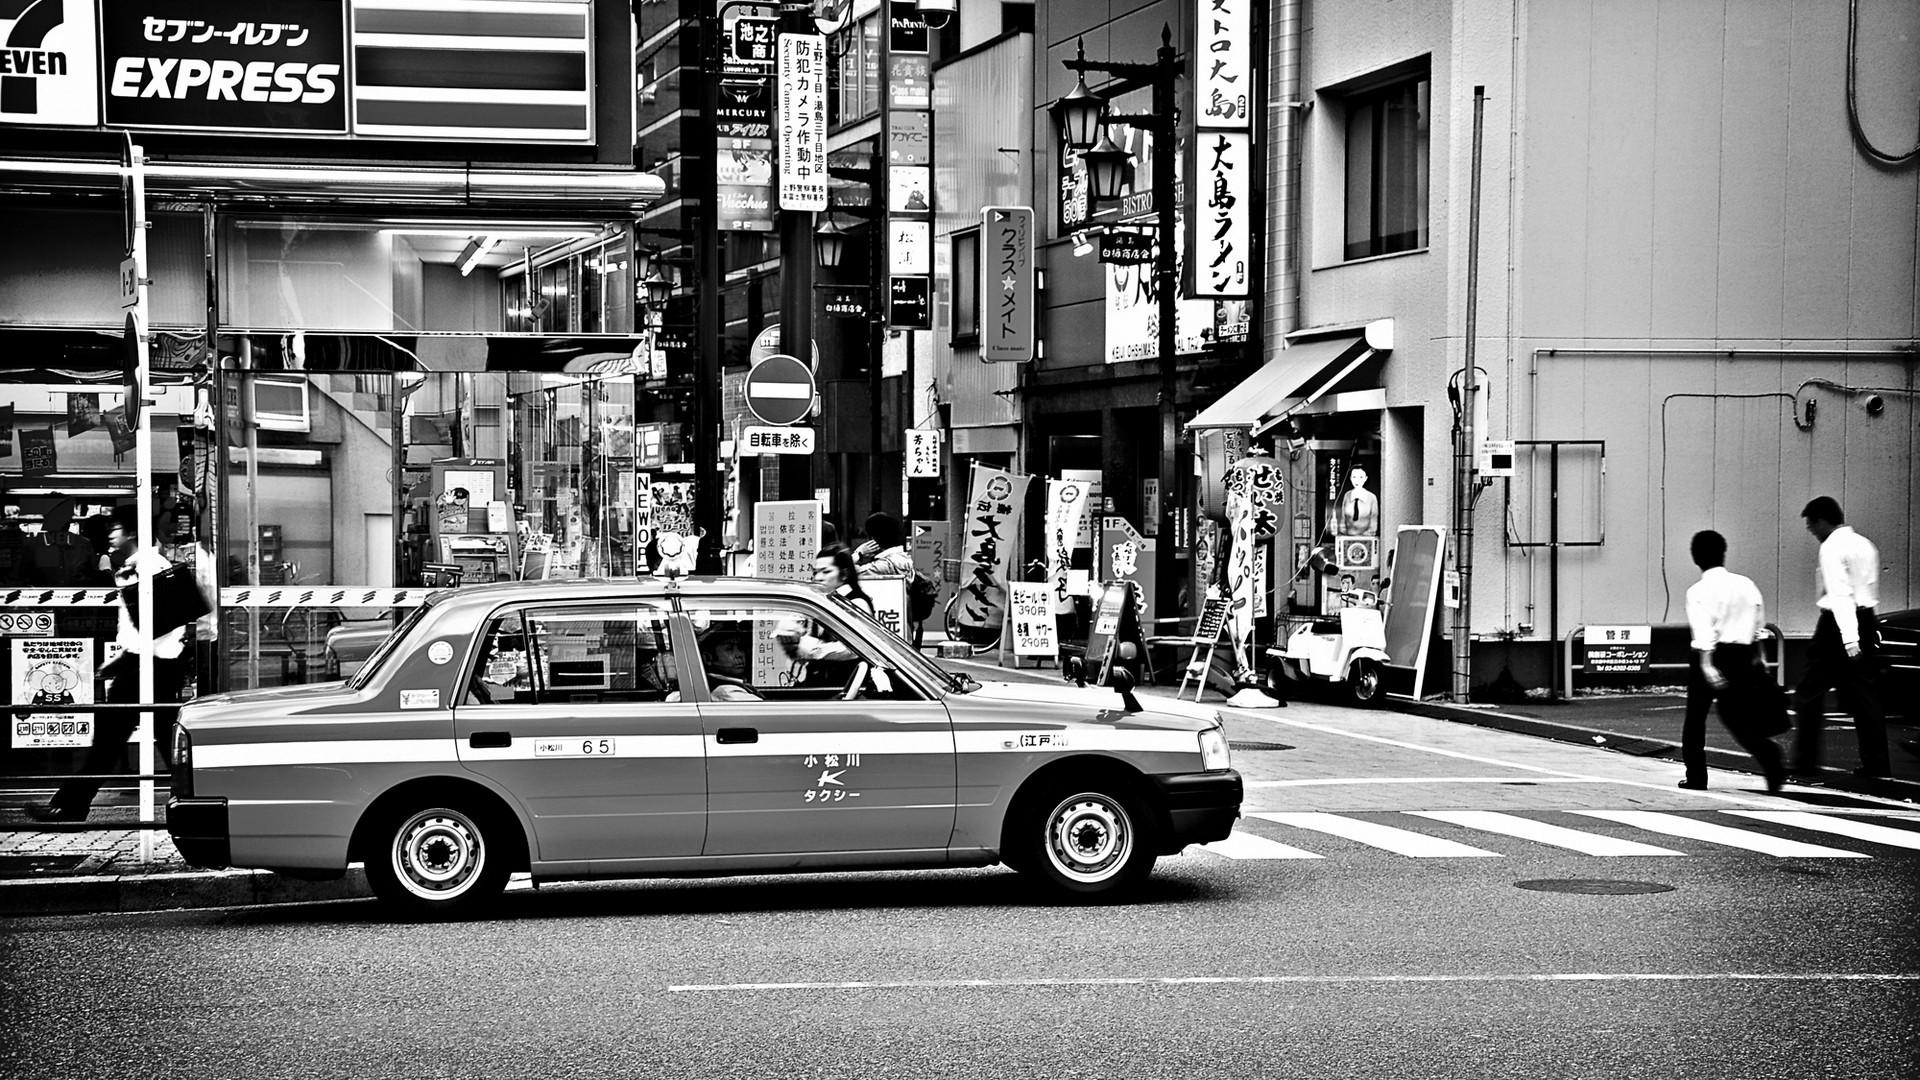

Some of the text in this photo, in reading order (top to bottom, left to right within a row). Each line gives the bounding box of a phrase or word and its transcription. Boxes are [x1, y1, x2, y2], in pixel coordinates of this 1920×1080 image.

[752, 43, 775, 59] 商
[111, 56, 340, 104] EXPRESS
[716, 108, 767, 117] MERCURY
[783, 38, 793, 175] Security Camera Operating
[796, 39, 811, 180] 防犯カメラ作動中
[716, 124, 730, 133] UB
[1122, 191, 1154, 216] BISTRO
[1208, 134, 1237, 292] 大島ラーメン
[732, 220, 752, 230] 2F
[750, 432, 808, 448] 自転車を除く
[1104, 519, 1121, 529] 1F
[1018, 605, 1047, 617] 390円
[1021, 637, 1050, 648] 290円
[803, 754, 861, 768] 小松川
[803, 789, 861, 803] タクシー
